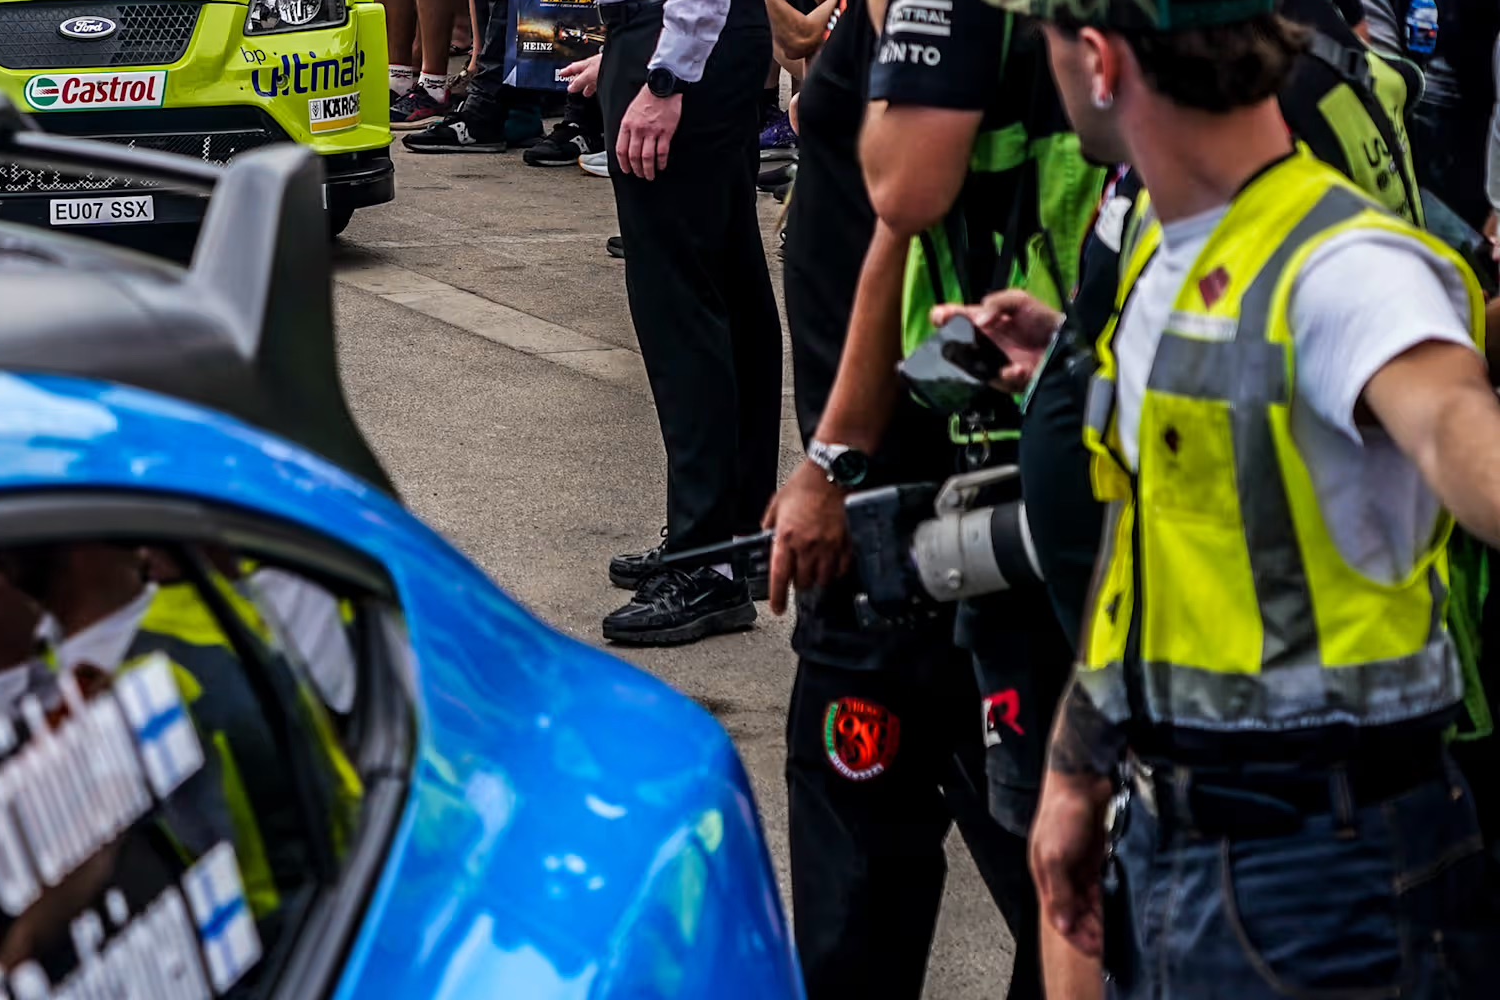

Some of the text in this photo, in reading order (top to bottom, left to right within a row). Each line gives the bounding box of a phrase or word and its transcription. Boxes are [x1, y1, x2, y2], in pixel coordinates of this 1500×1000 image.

[73, 18, 103, 32] Ford
[240, 46, 267, 65] bp
[522, 41, 553, 51] HEINZ
[61, 76, 157, 105] Castrol
[55, 200, 149, 221] EU07 SSX
